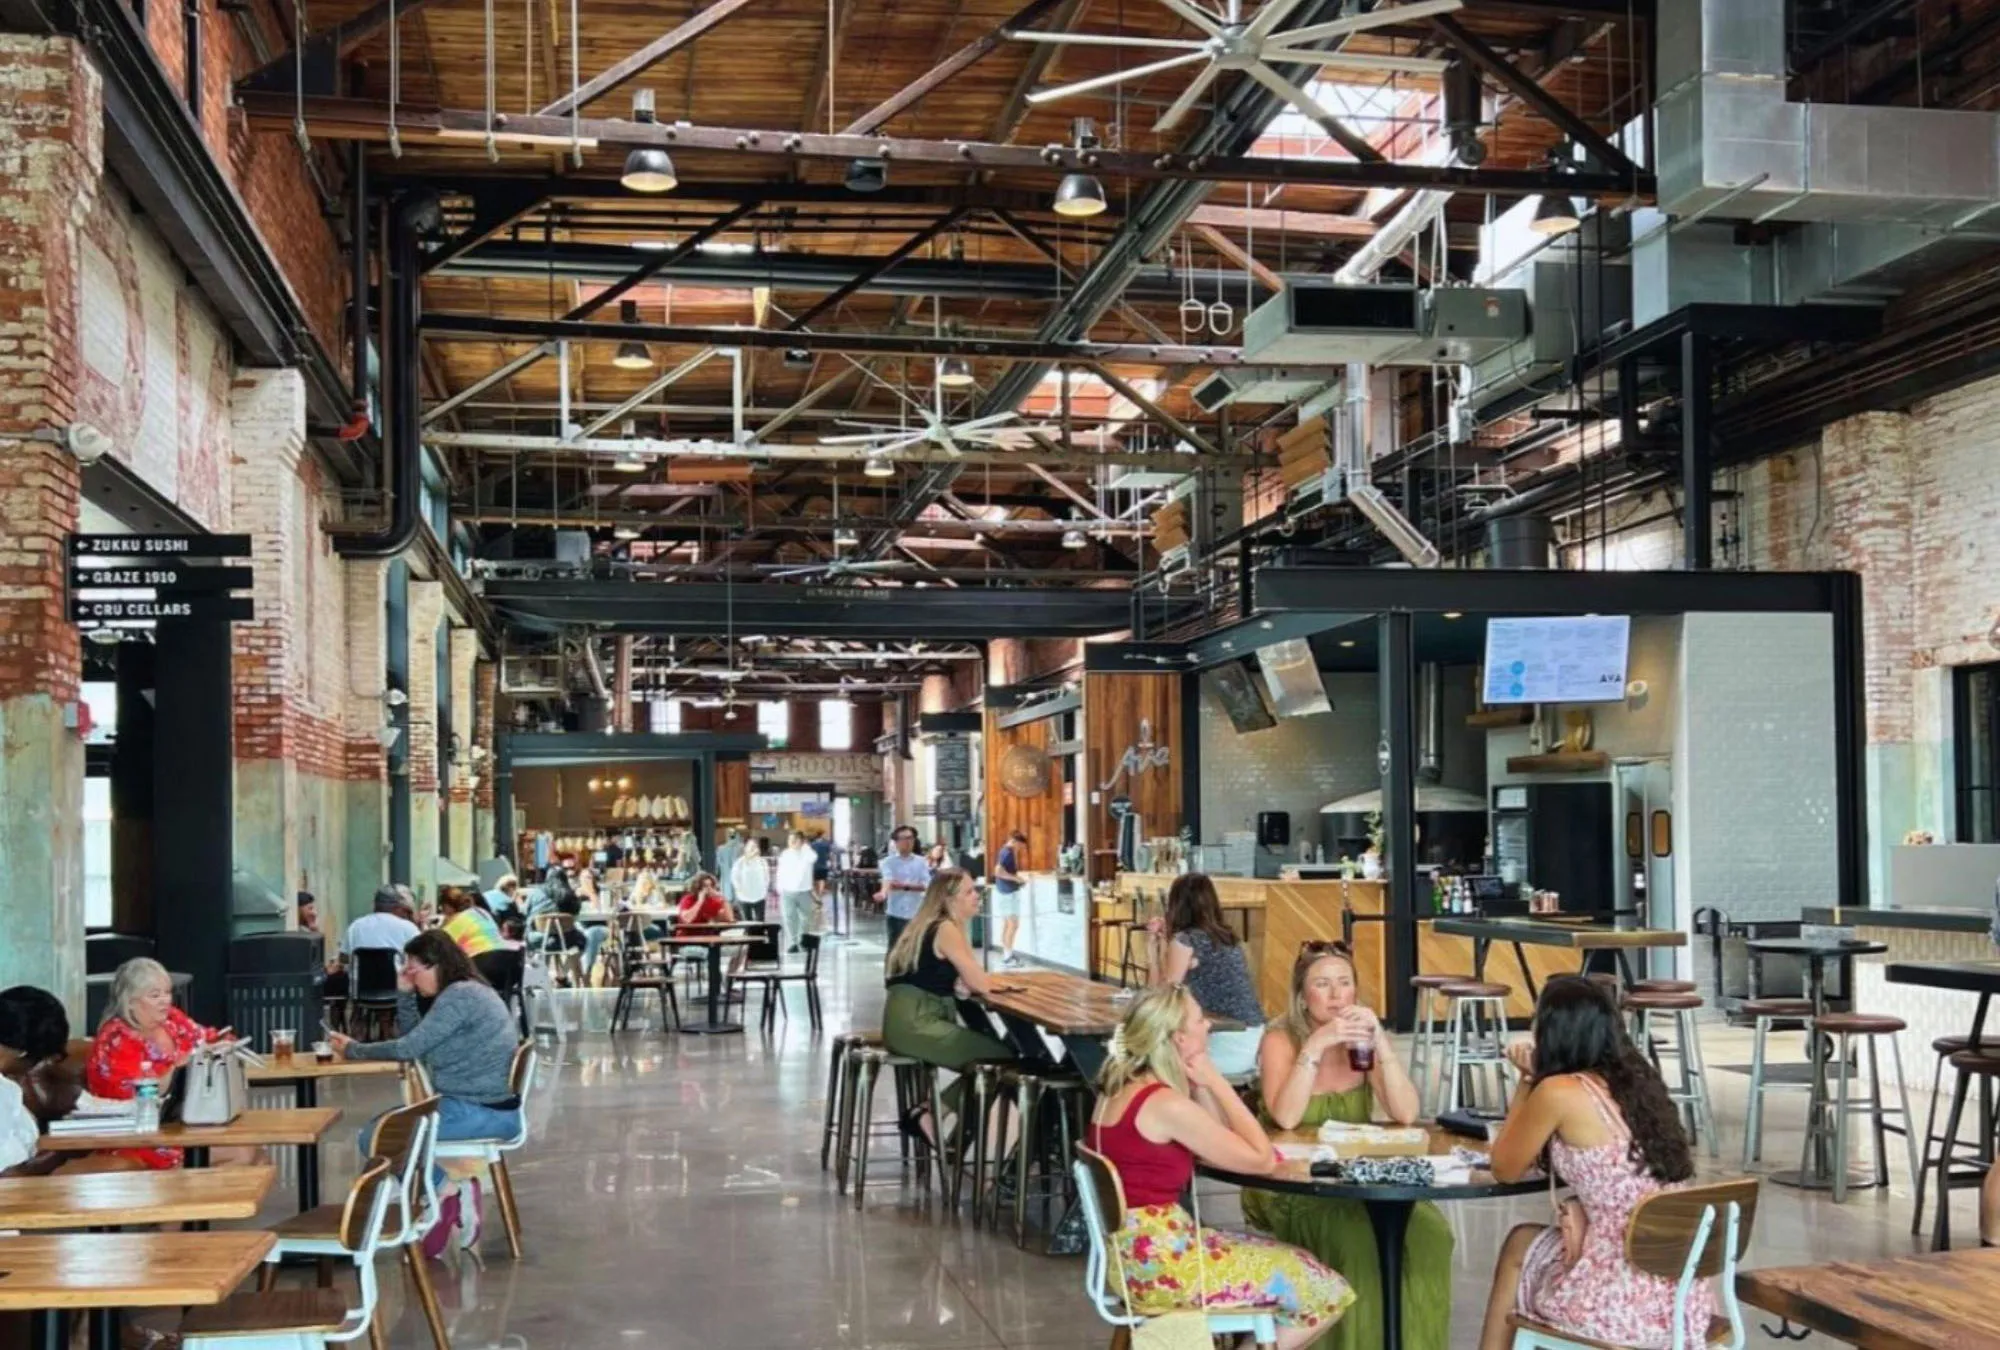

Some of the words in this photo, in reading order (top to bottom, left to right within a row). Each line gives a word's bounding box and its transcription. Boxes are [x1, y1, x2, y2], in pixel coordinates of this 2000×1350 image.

[92, 539, 141, 551] ZUKKU
[145, 539, 188, 551] SUSHI
[92, 571, 140, 583] GRAZE
[144, 571, 177, 583] 1910
[93, 604, 122, 615] CRU
[127, 603, 191, 615] CELLARS
